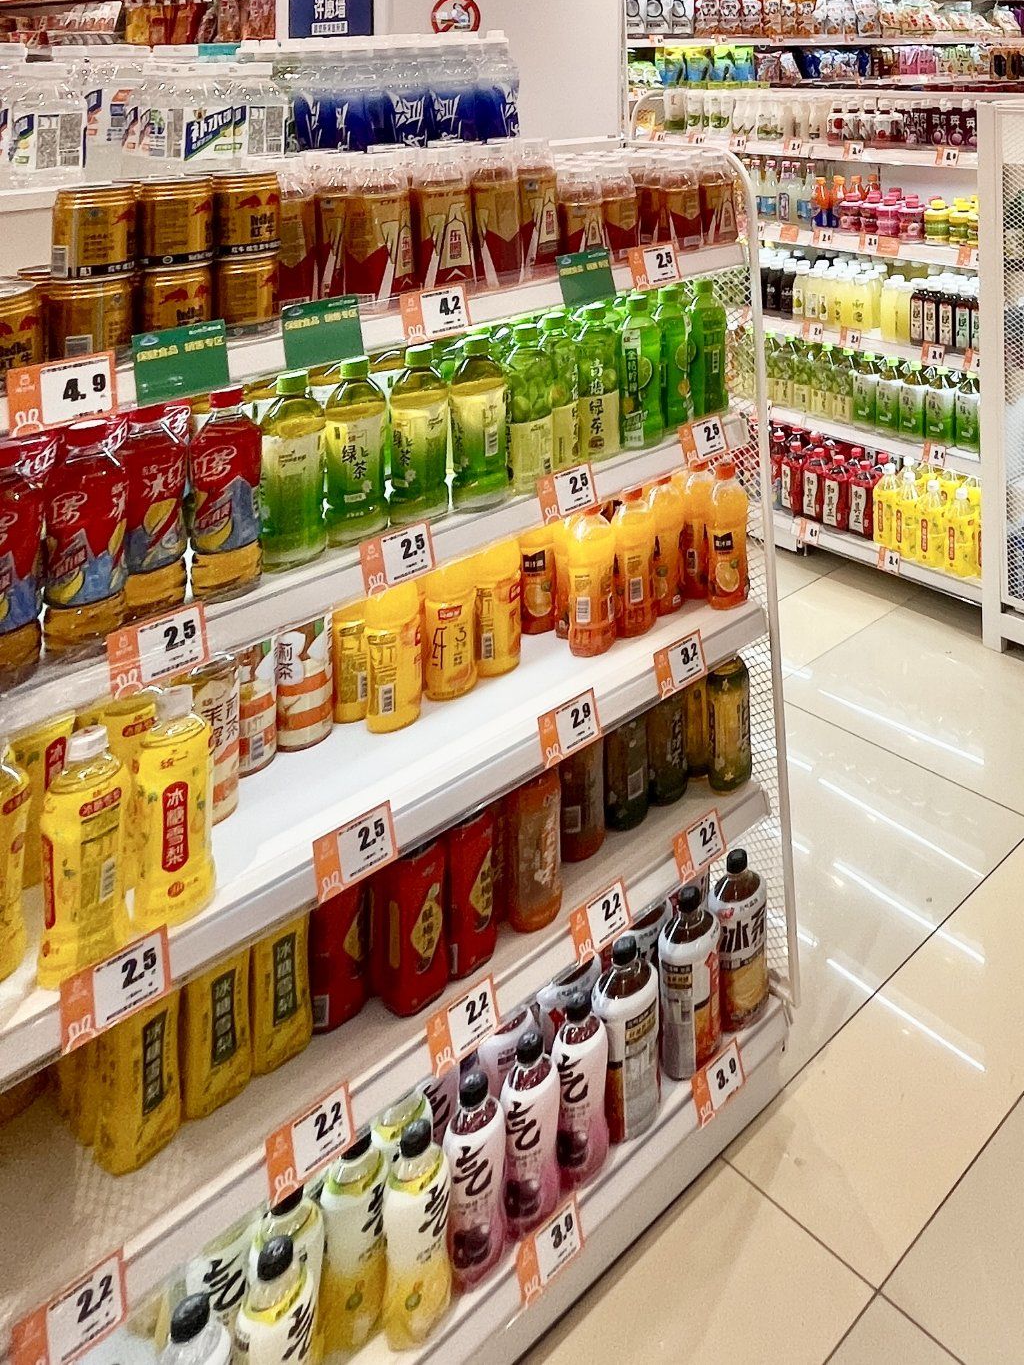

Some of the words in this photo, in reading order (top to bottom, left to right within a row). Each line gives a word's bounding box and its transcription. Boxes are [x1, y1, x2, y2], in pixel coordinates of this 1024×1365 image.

[439, 296, 461, 315] 4.2
[62, 373, 107, 402] 4.9
[400, 534, 425, 560] 2.5
[166, 787, 184, 867] 冰糖雪梨
[121, 947, 157, 989] 2.5
[505, 1101, 541, 1151] 气
[453, 1142, 493, 1196] 气
